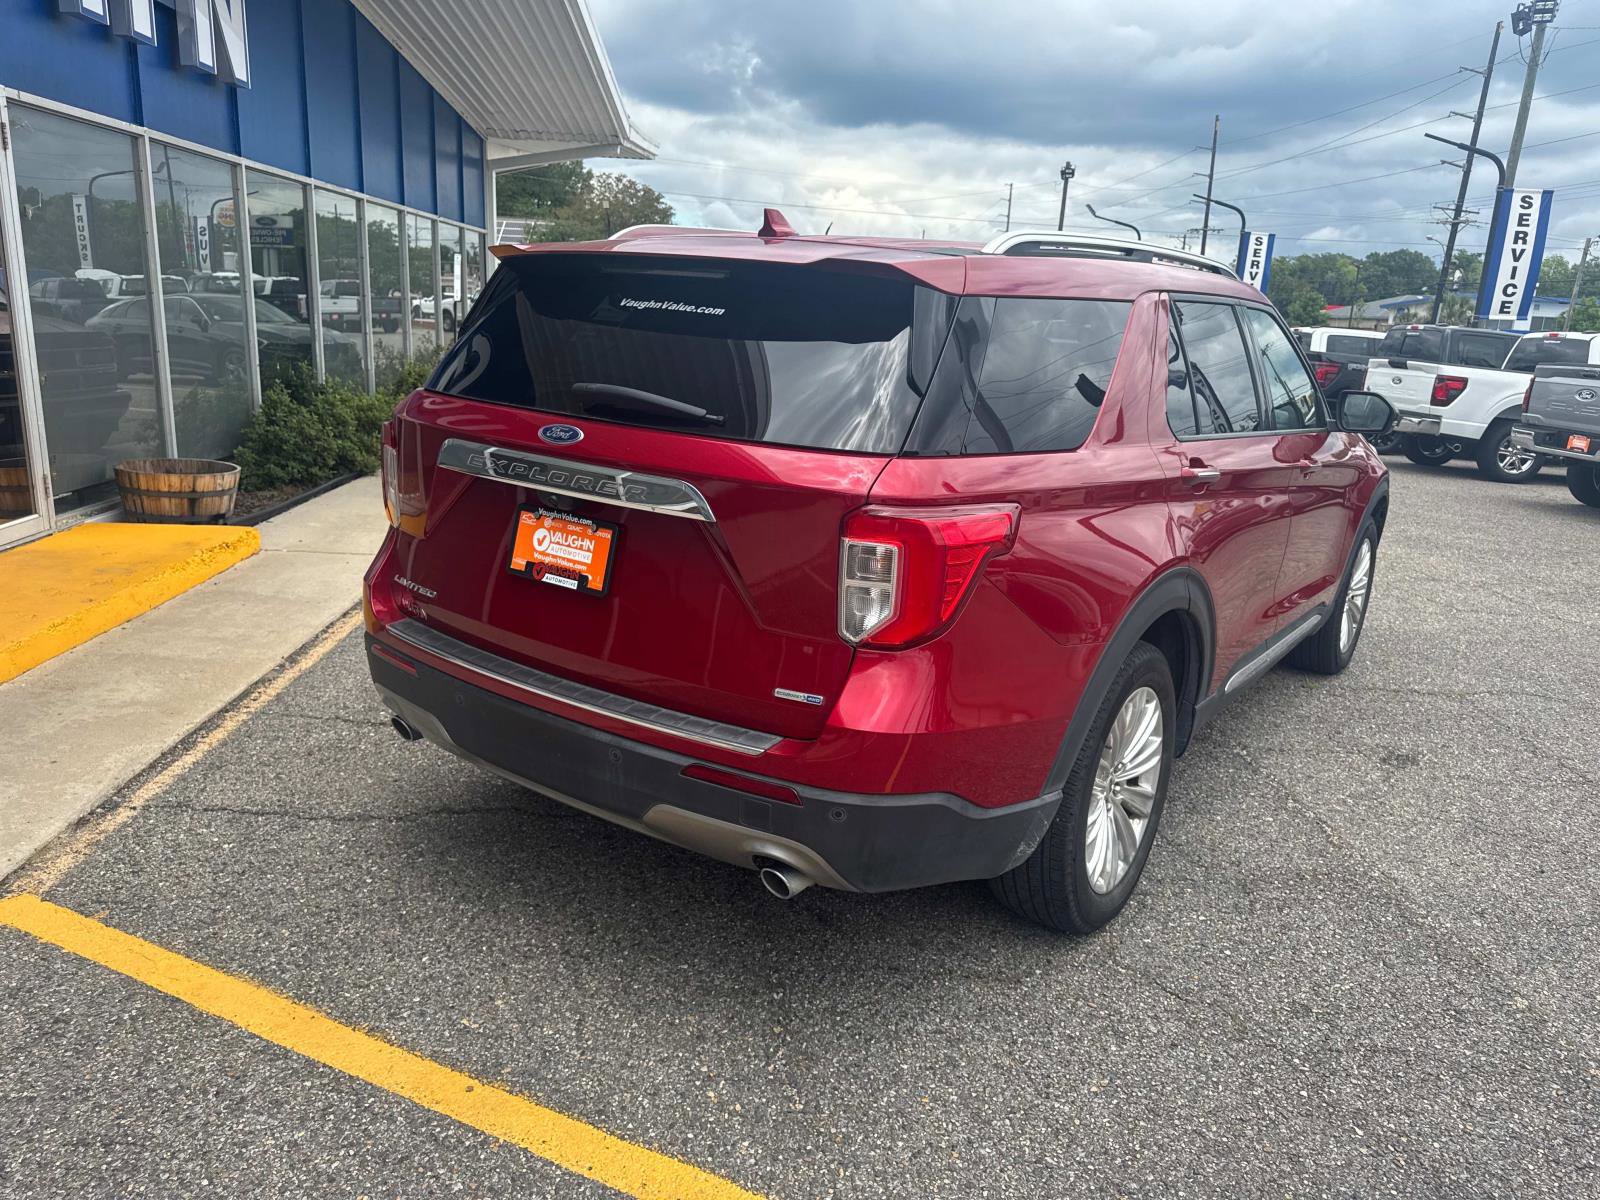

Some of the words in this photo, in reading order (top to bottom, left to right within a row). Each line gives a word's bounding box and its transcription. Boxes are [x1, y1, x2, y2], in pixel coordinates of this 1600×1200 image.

[1249, 236, 1264, 285] SERV
[1498, 195, 1534, 315] SERVICE
[620, 298, 725, 315] VaughnValue.com
[546, 425, 573, 439] Ford
[467, 453, 648, 501] EXPLORER
[538, 507, 593, 526] VaughnValue.com
[549, 530, 595, 552] VAUGHN
[534, 552, 587, 571] VaughnValue.com
[551, 546, 591, 561] AUTOMOTIVE
[544, 563, 580, 580] VAUGHN
[394, 574, 437, 597] LIMITED
[545, 576, 576, 588] AUTOMOTIVE
